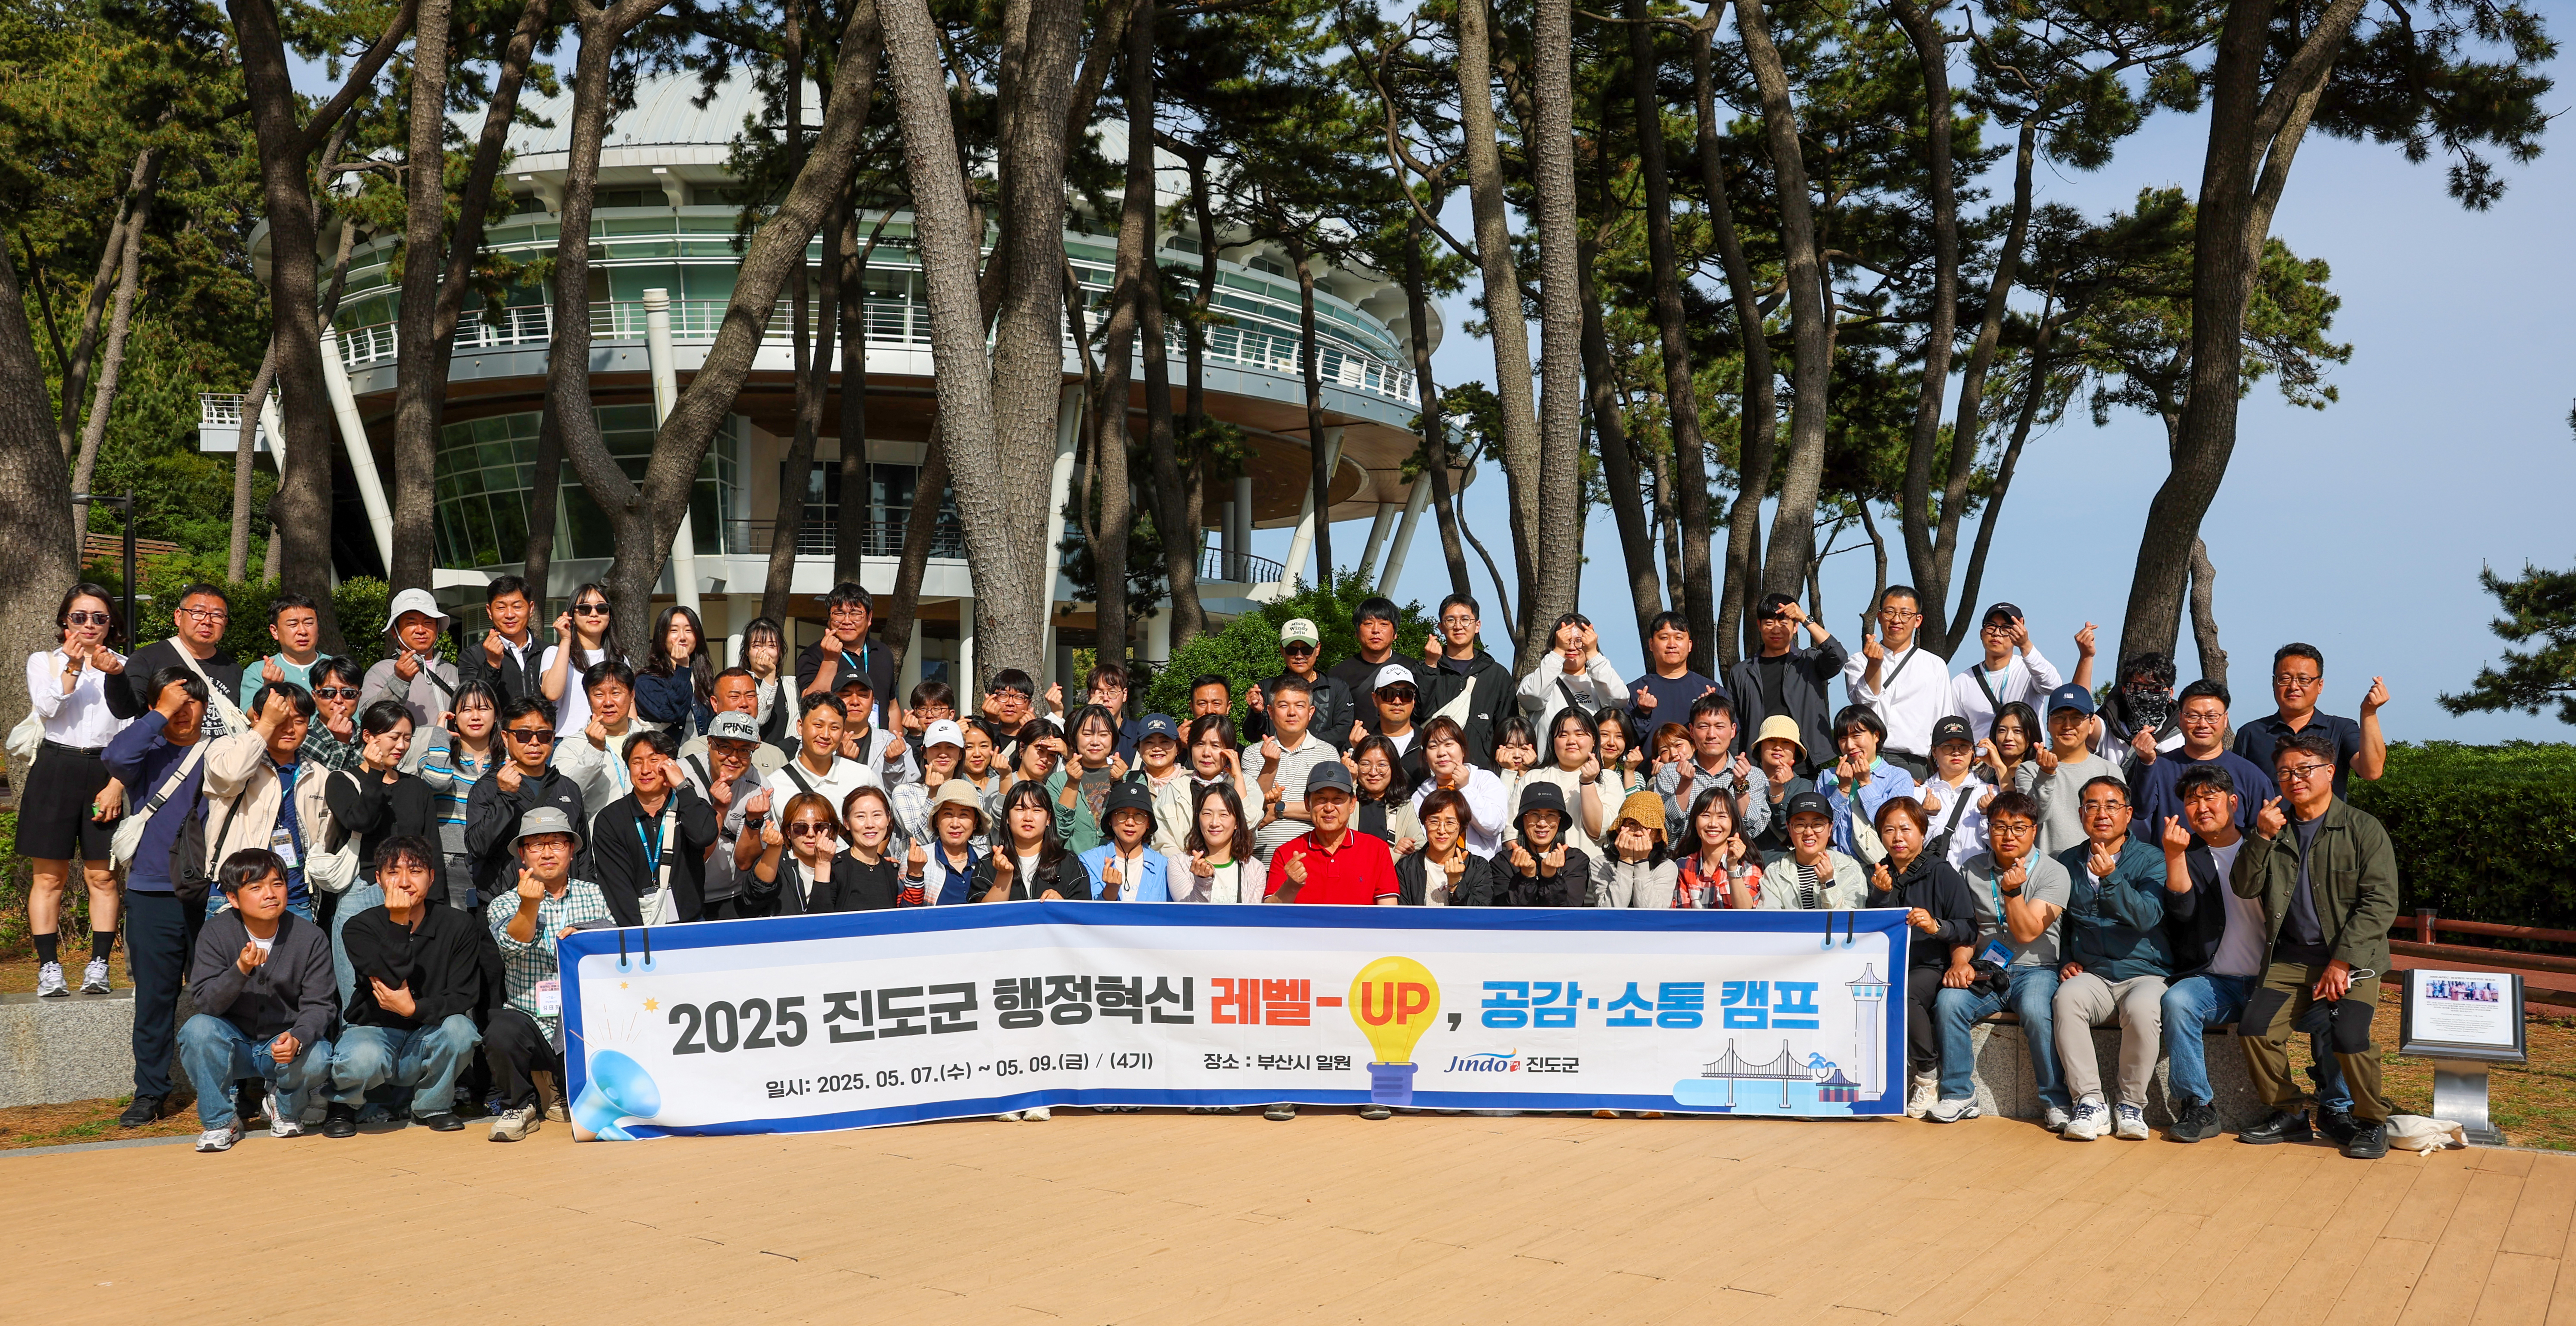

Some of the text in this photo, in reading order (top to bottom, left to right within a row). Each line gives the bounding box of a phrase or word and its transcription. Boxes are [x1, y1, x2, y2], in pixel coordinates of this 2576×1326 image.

[216, 680, 231, 694] TIME
[723, 722, 753, 735] PING
[669, 996, 807, 1055] 2025
[823, 982, 978, 1044] 진도군
[993, 976, 1194, 1029] 행정혁신
[1720, 980, 1819, 1030] 캠프
[1204, 1053, 1239, 1070] 장소
[1258, 1054, 1310, 1070] 부산시
[1316, 1055, 1351, 1071] 일원
[1444, 1056, 1507, 1073] Jindo
[1526, 1057, 1579, 1073] 진도군
[766, 1078, 810, 1098] 일시:
[817, 1073, 869, 1093] 2025.
[876, 1070, 904, 1087] 05.
[911, 1061, 971, 1085] 07.(수)
[996, 1059, 1023, 1077] 05.
[1030, 1052, 1088, 1073] 09.(금)
[1110, 1052, 1153, 1070] (4기)
